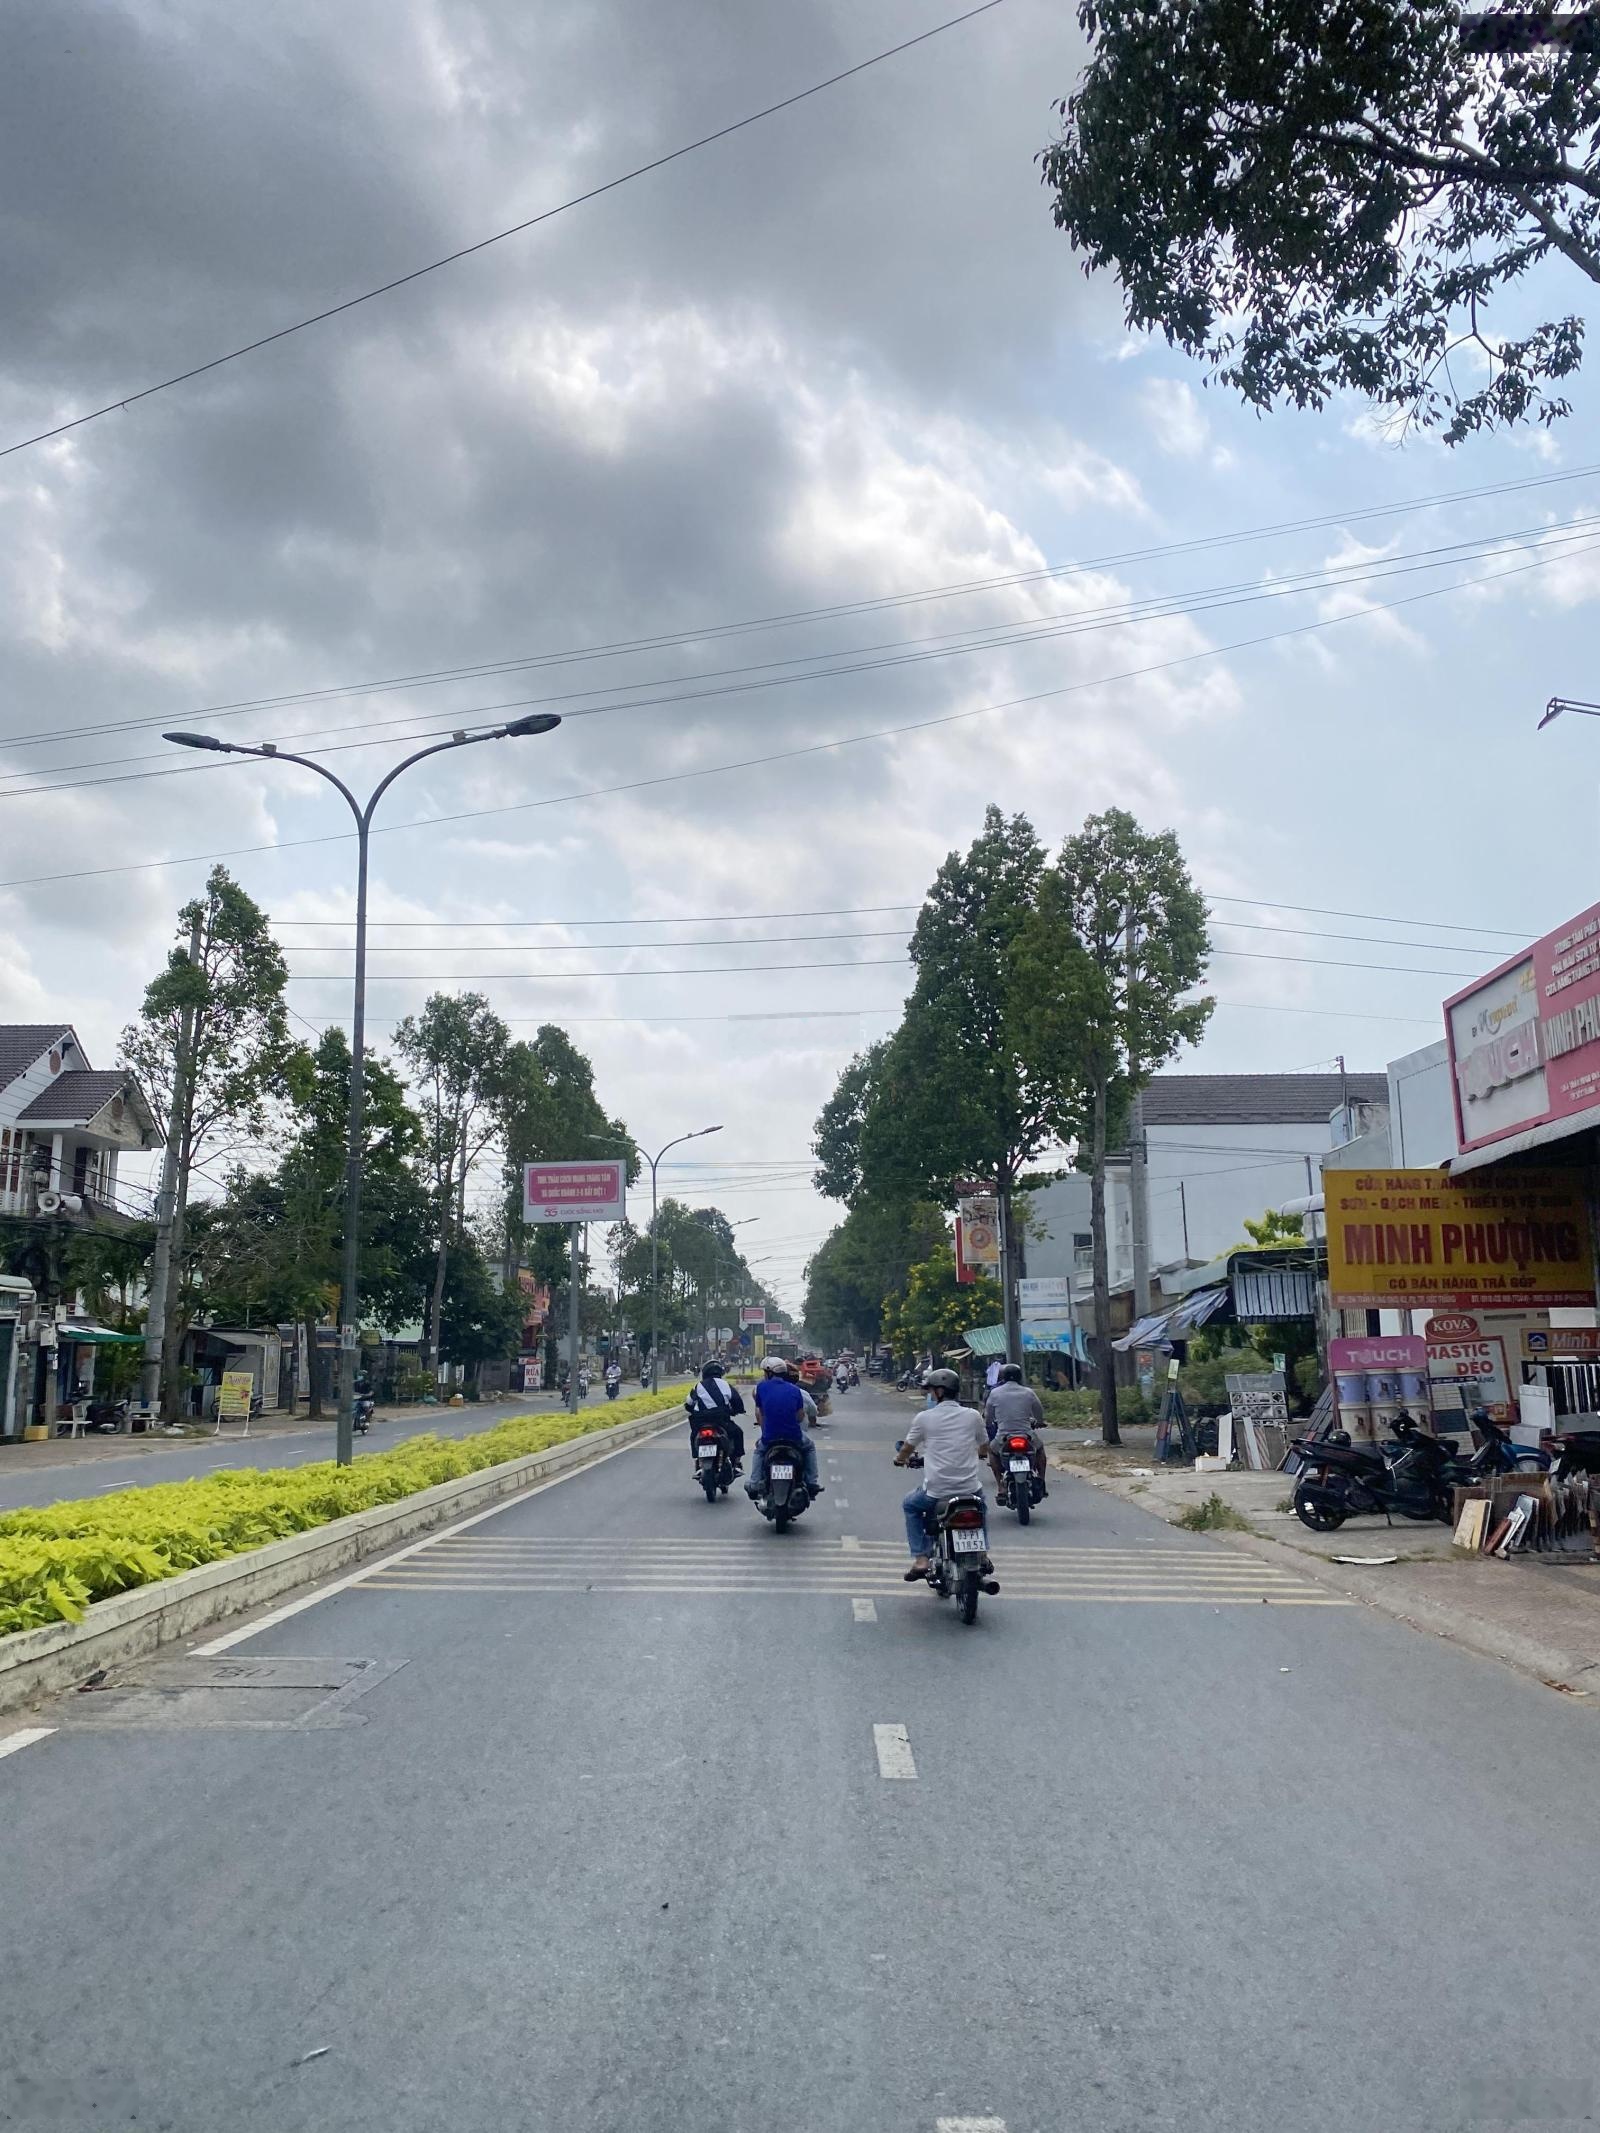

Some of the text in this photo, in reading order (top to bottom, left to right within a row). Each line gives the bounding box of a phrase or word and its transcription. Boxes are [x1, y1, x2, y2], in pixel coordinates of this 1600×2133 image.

[1385, 1176, 1421, 1191] HÀNG
[1343, 1217, 1580, 1270] MINH PHƯỢNG
[1411, 1275, 1437, 1289] BÁN
[1442, 1275, 1477, 1289] HÀNG
[1510, 1274, 1537, 1288] GÓP
[1433, 1318, 1471, 1331] KOVA
[1552, 1332, 1590, 1348] Minh
[1347, 1348, 1411, 1364] TOUCH
[1426, 1343, 1490, 1360] MASTIC
[526, 1366, 539, 1376] RỬA
[1457, 1357, 1494, 1376] DẺO
